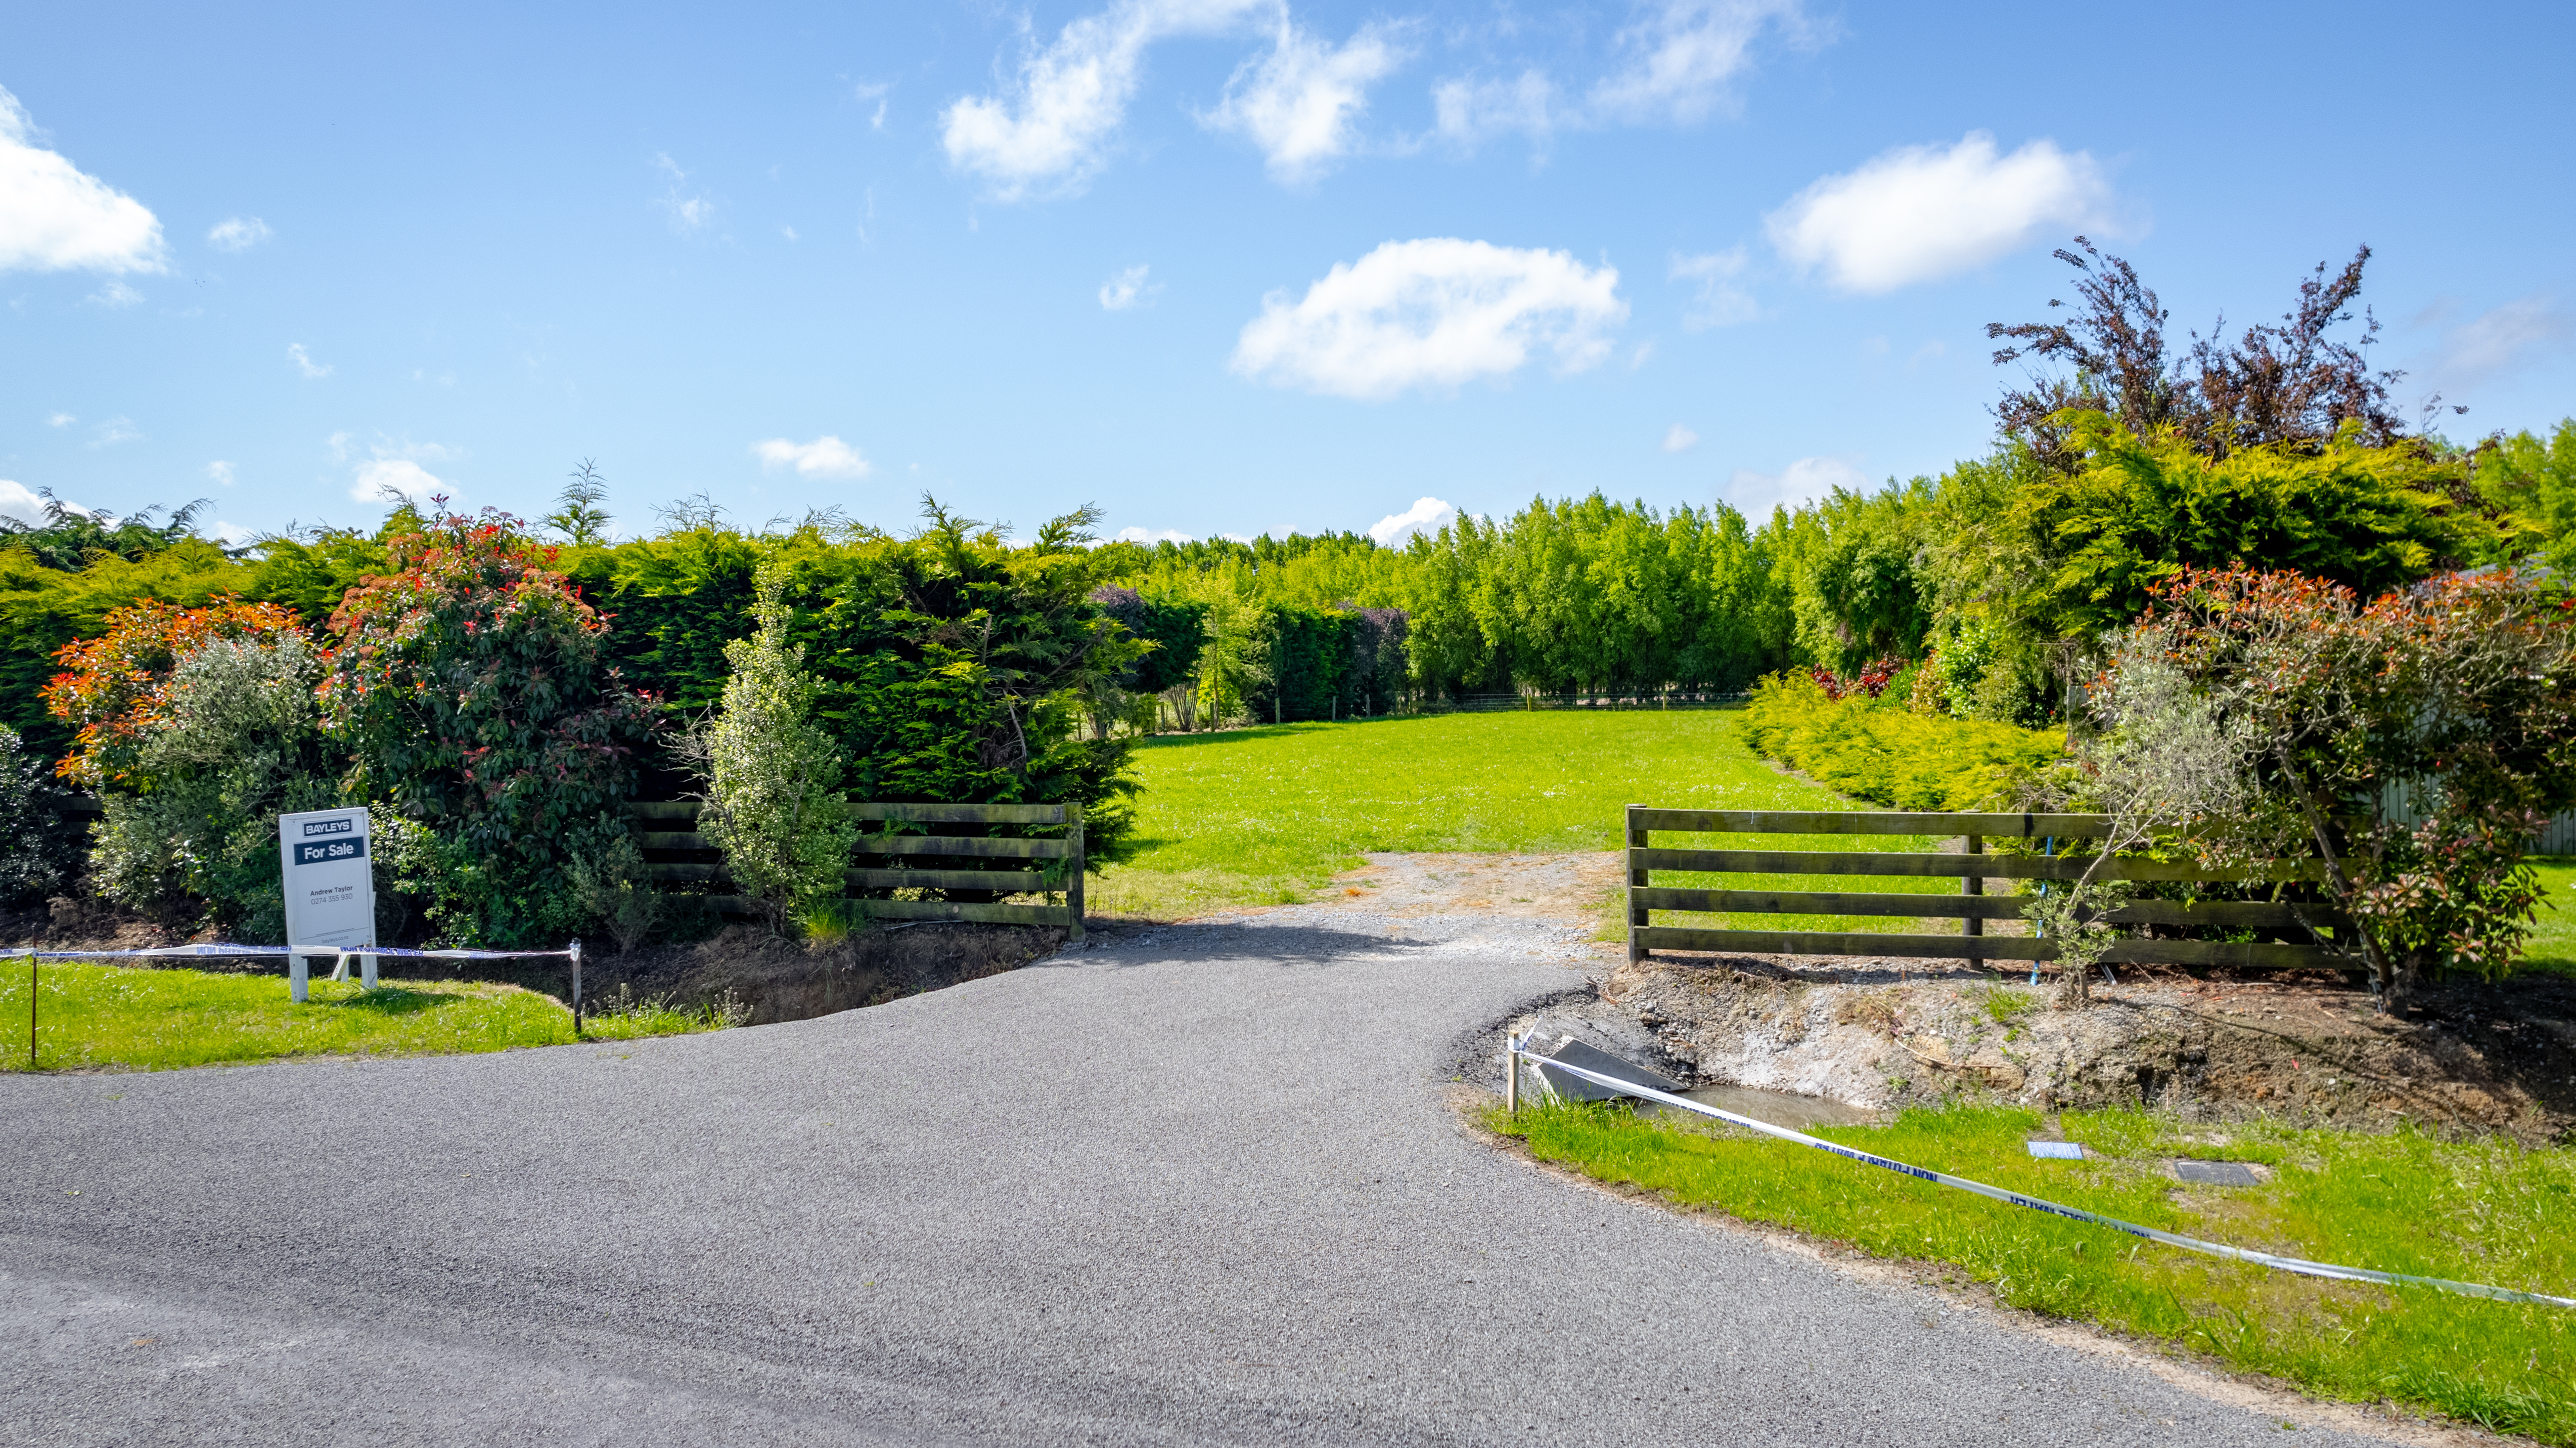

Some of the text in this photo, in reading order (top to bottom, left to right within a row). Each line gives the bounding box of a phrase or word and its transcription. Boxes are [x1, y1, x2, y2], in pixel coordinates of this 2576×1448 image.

[306, 821, 349, 834] BAYLEYS
[304, 843, 353, 859] For Sale
